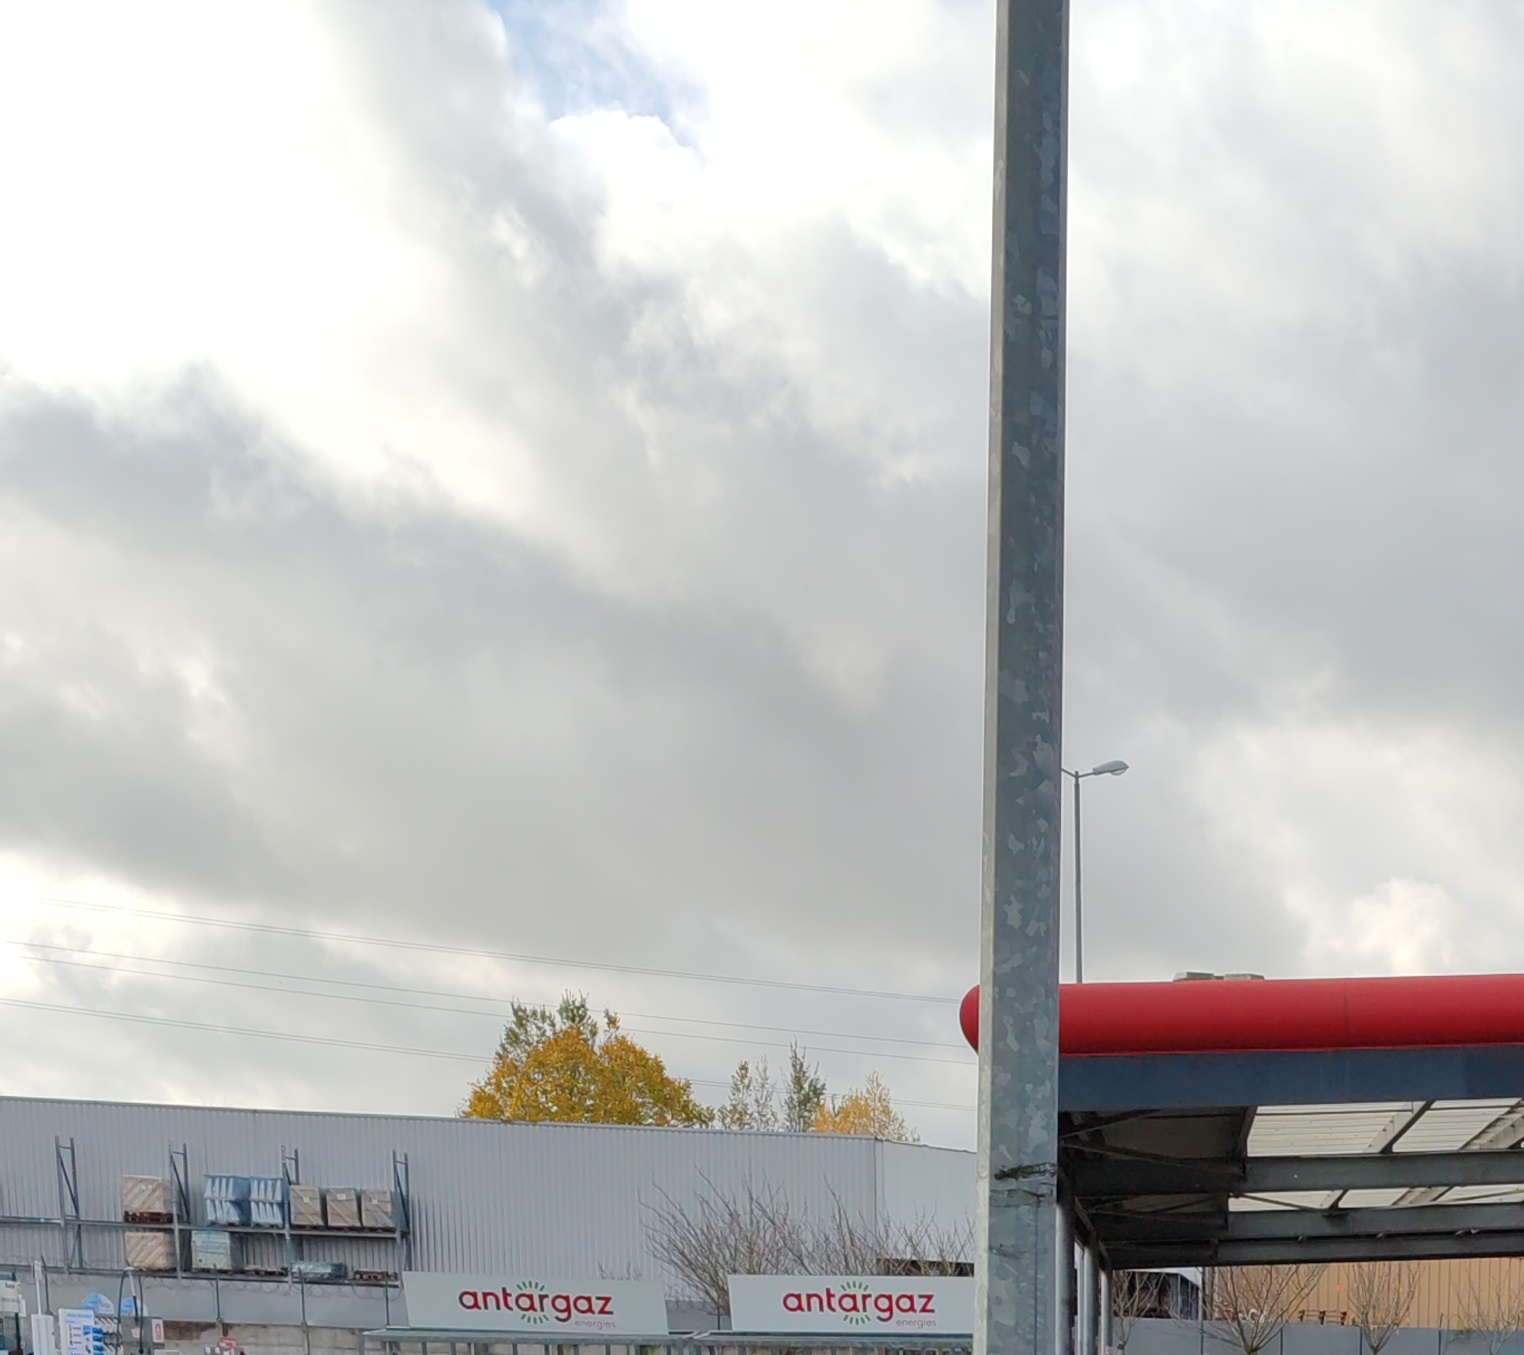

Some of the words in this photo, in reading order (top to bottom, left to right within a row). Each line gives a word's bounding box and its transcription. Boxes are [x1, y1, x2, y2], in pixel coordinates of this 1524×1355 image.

[458, 1287, 614, 1322] antargaz
[782, 1287, 936, 1322] antargaz
[574, 1319, 616, 1330] energies
[895, 1317, 937, 1329] energies
